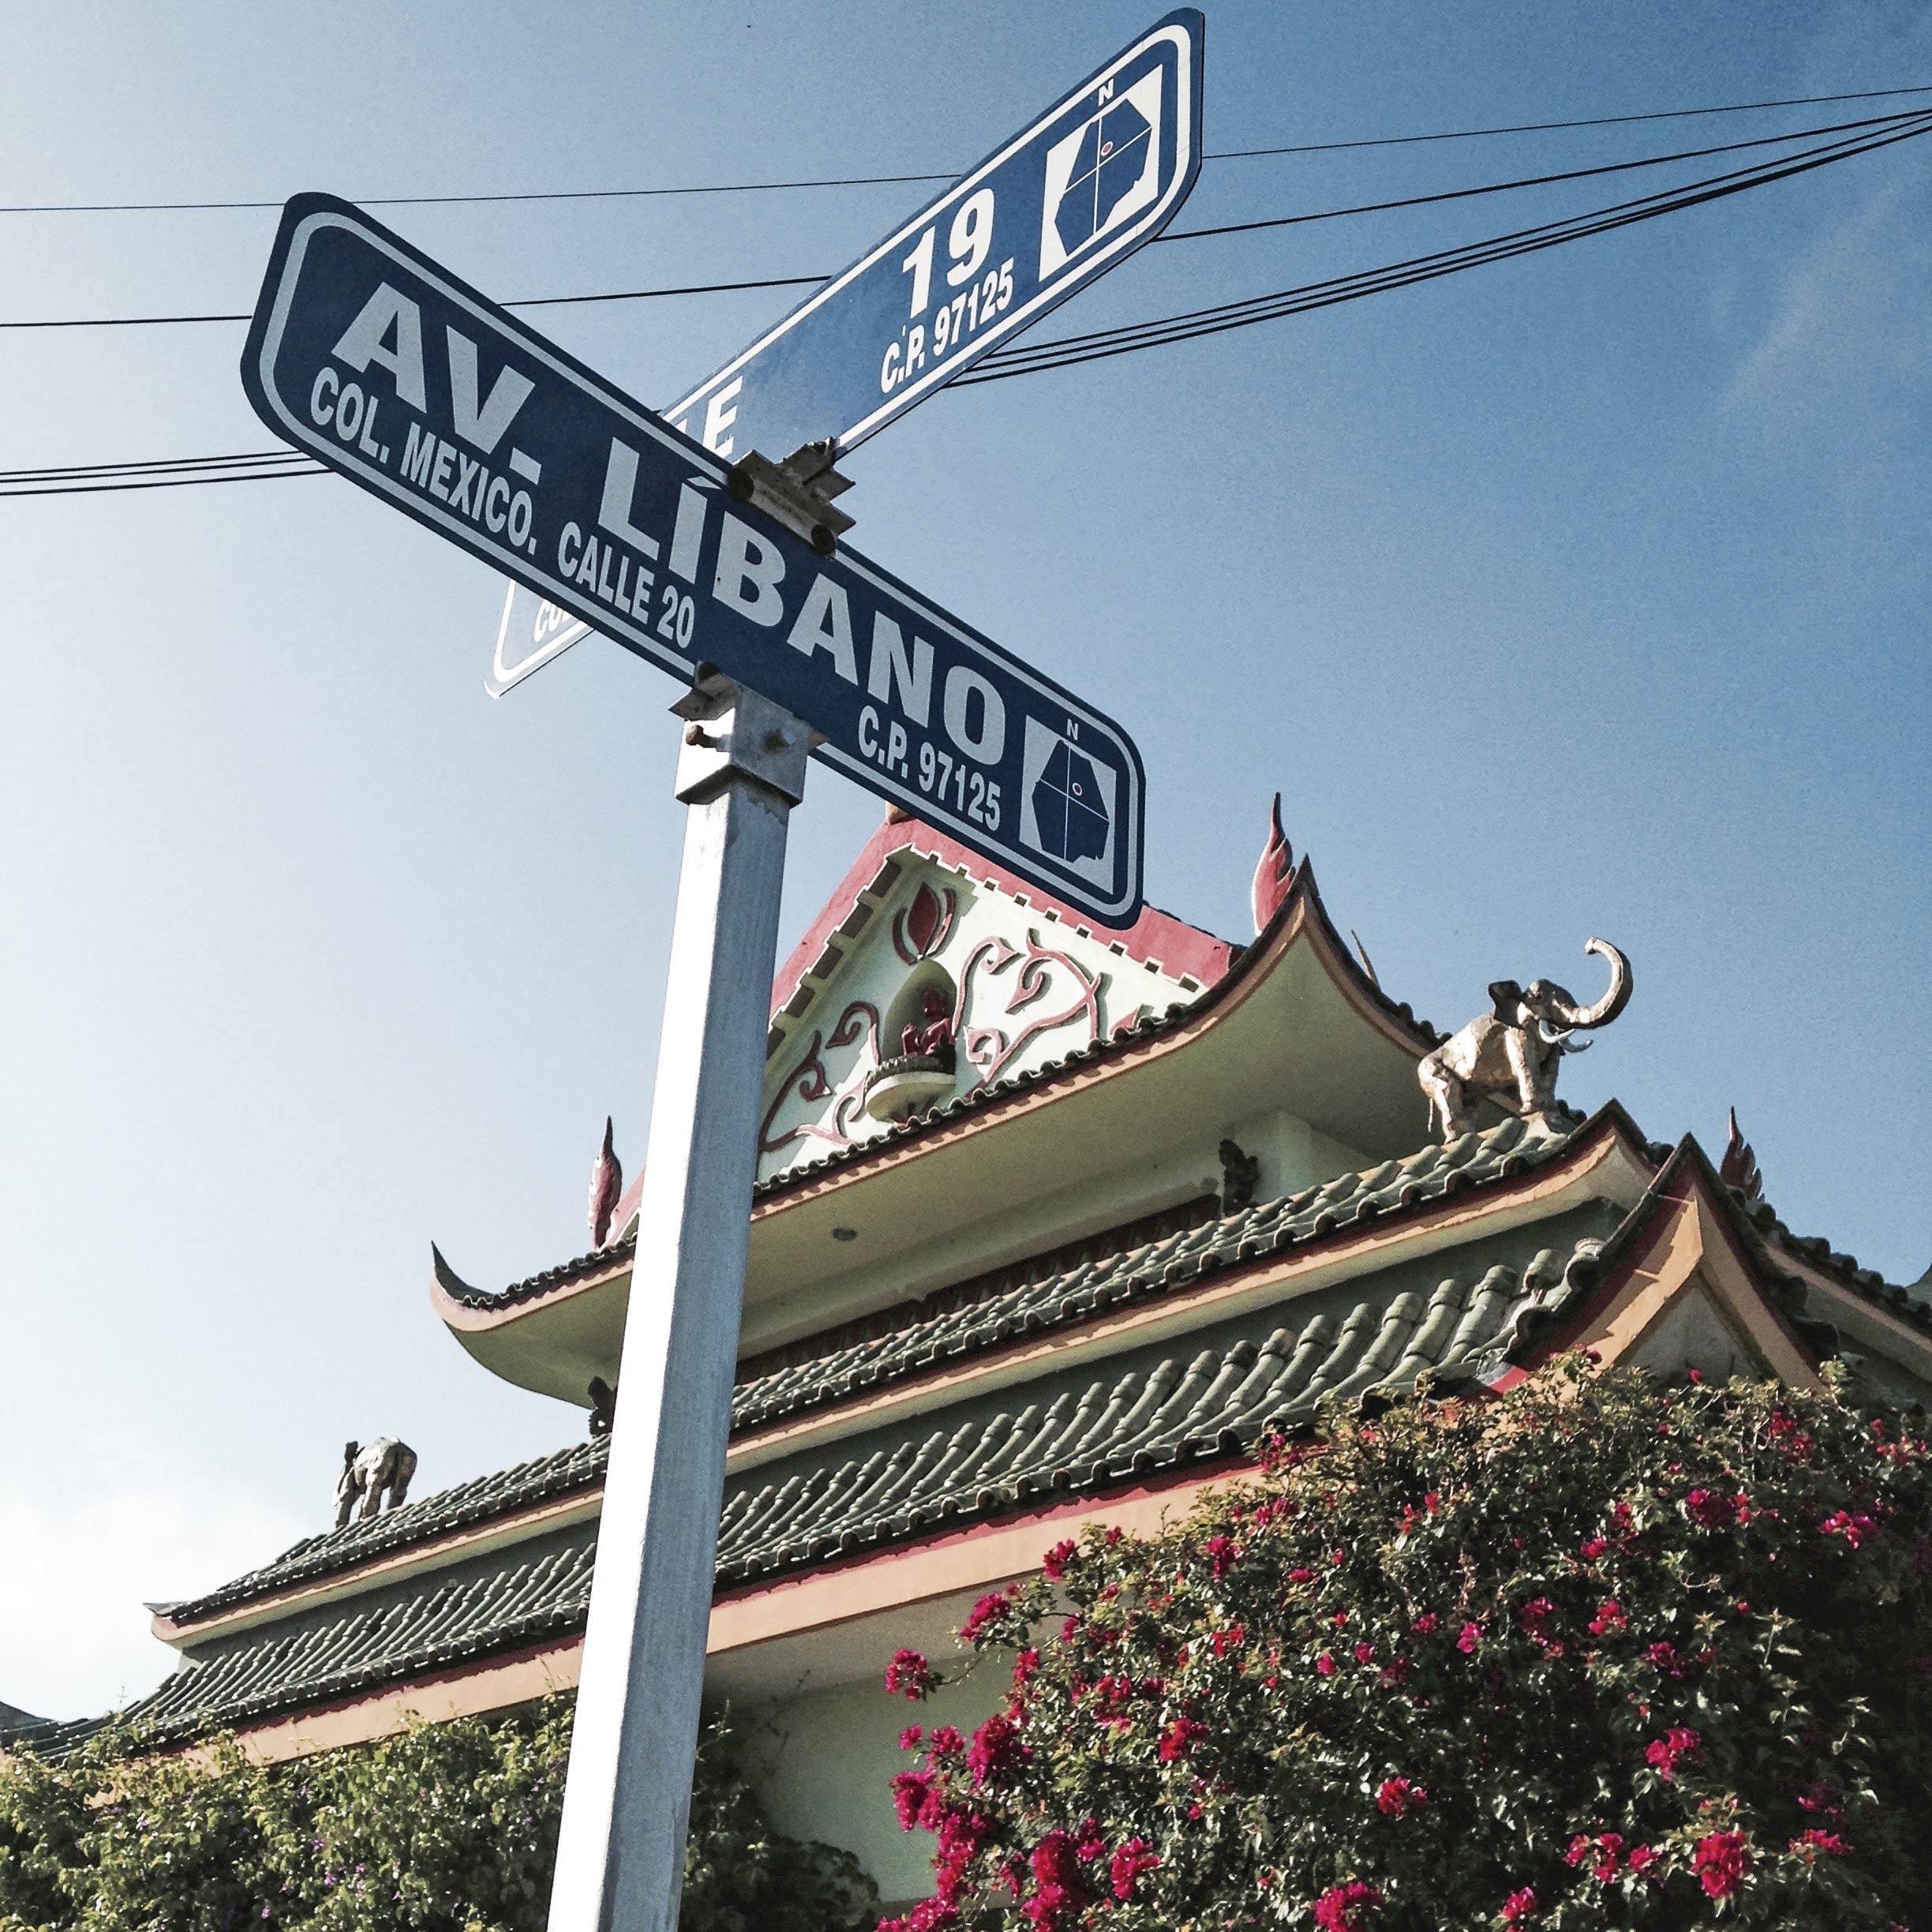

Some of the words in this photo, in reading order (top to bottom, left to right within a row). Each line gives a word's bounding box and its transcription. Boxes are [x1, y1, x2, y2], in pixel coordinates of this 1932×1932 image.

[1098, 77, 1114, 107] N
[902, 188, 994, 319] 19
[880, 324, 926, 394] C.P.
[933, 257, 1014, 357] 97125
[331, 282, 541, 485] AV.
[597, 436, 1006, 766] LÍBANO
[309, 367, 390, 464] COL.
[400, 421, 536, 555] MEXICO.
[558, 521, 655, 625] CALLE
[657, 585, 695, 649] 20
[858, 705, 908, 779] C.P.
[918, 744, 1002, 831] 97125
[1065, 718, 1079, 741] N
